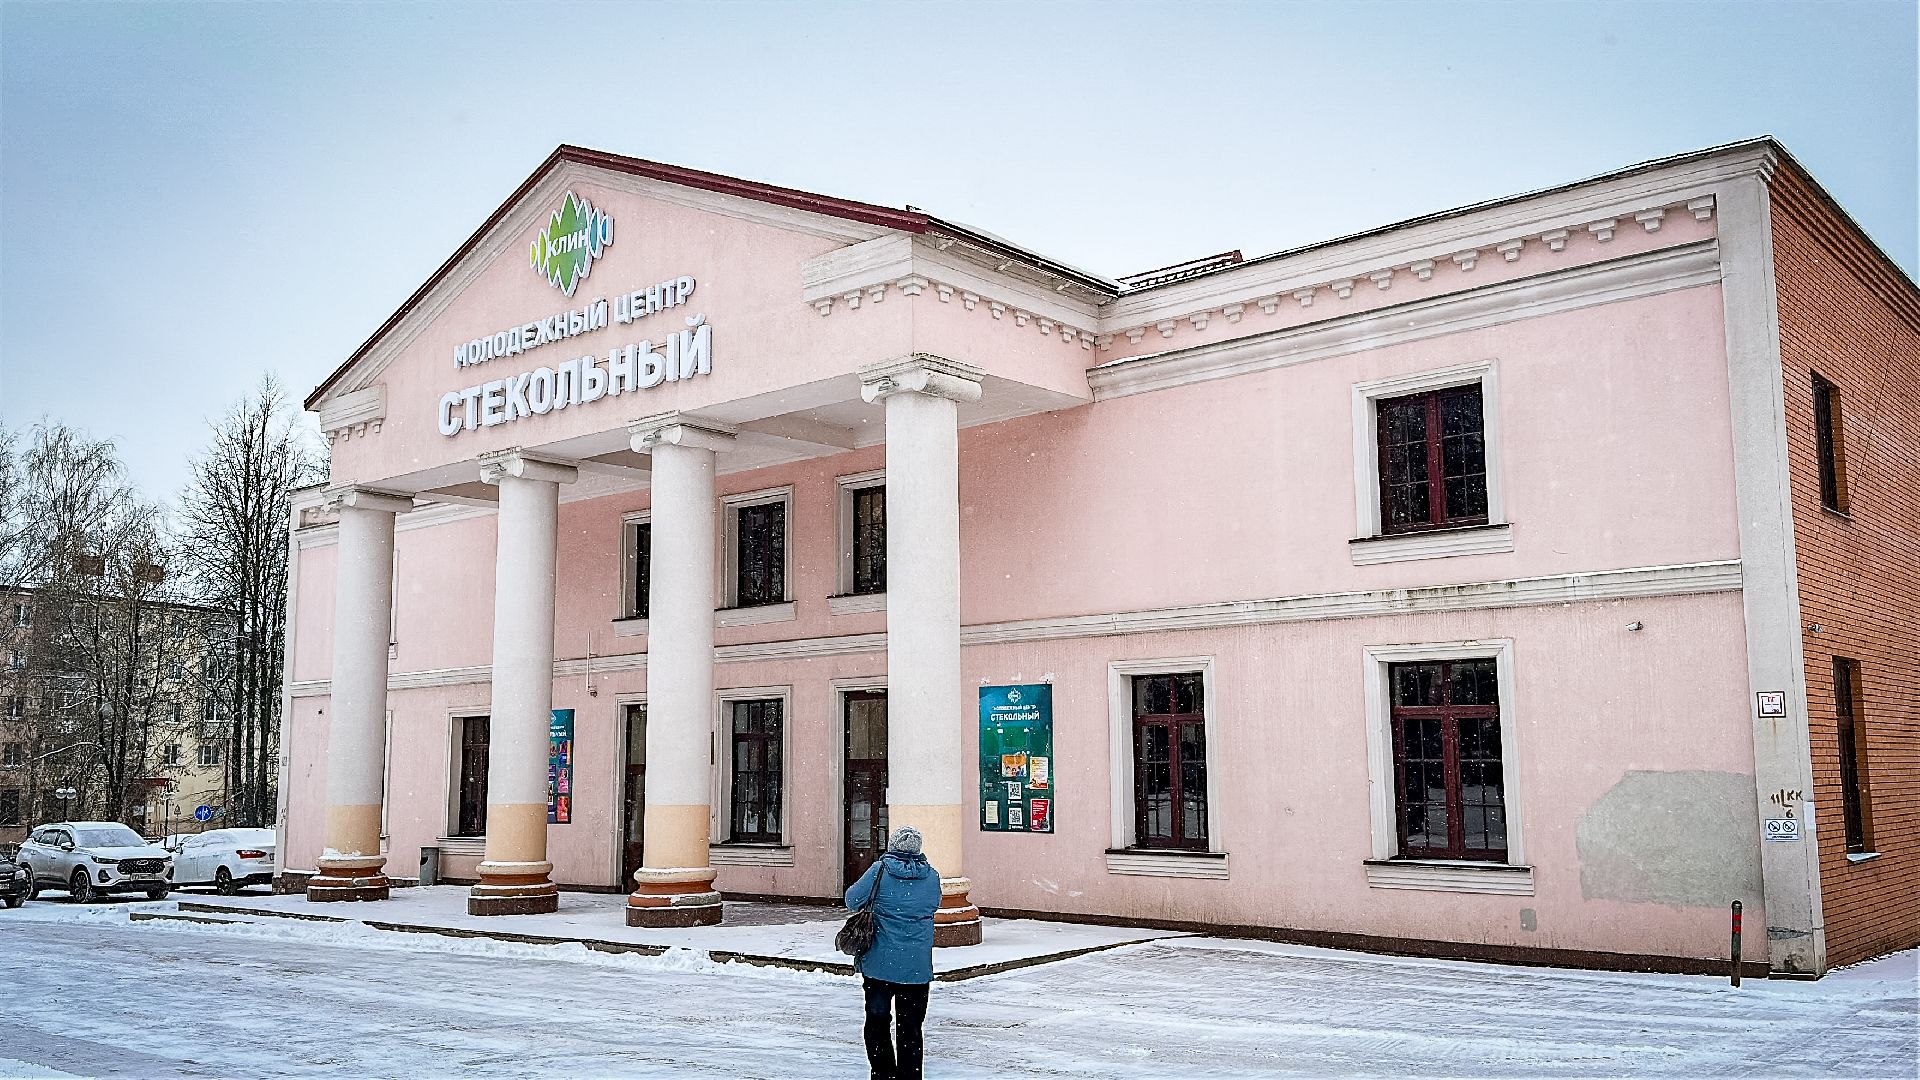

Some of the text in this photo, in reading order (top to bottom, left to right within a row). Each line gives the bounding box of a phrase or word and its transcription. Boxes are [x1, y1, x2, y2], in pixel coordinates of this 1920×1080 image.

[547, 228, 589, 259] КЛИН
[453, 275, 696, 369] МОЛОДЕЖНЫЙ ЦЕНТР
[438, 313, 713, 437] СТЕКОЛЬНЫЙ
[990, 710, 1040, 722] СТЕКОЛЬНЫЙ
